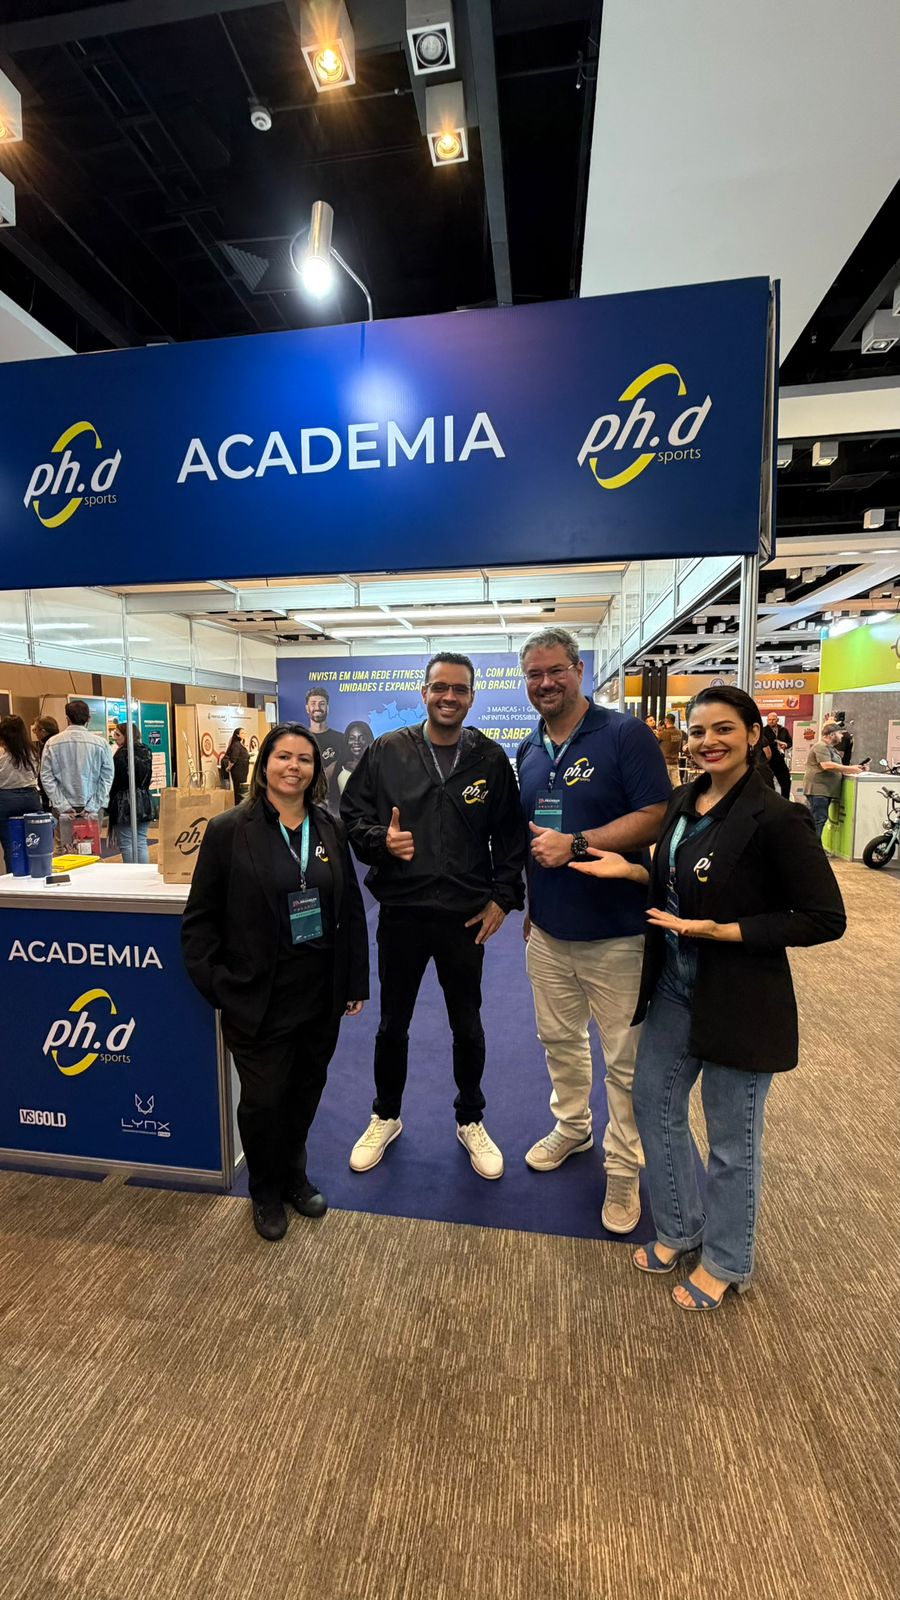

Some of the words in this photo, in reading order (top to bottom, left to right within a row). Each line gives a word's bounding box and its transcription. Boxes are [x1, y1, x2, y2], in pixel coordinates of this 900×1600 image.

[577, 394, 712, 467] ph.d
[176, 412, 506, 484] ACADEMIA
[657, 448, 701, 464] sports
[23, 448, 122, 508] ph.d
[84, 494, 117, 507] sports
[308, 671, 337, 681] INVISTA
[339, 671, 351, 680] EM
[352, 671, 369, 680] UMA
[370, 670, 391, 680] REDE
[392, 669, 425, 679] FITNESS
[486, 667, 504, 678] COM
[339, 682, 377, 692] UNIDADES
[378, 682, 384, 691] E
[475, 680, 486, 690] NO
[501, 727, 532, 740] SABER
[8, 939, 163, 969] ACADEMIA
[42, 1011, 136, 1056] ph.d
[100, 1053, 131, 1064] sports
